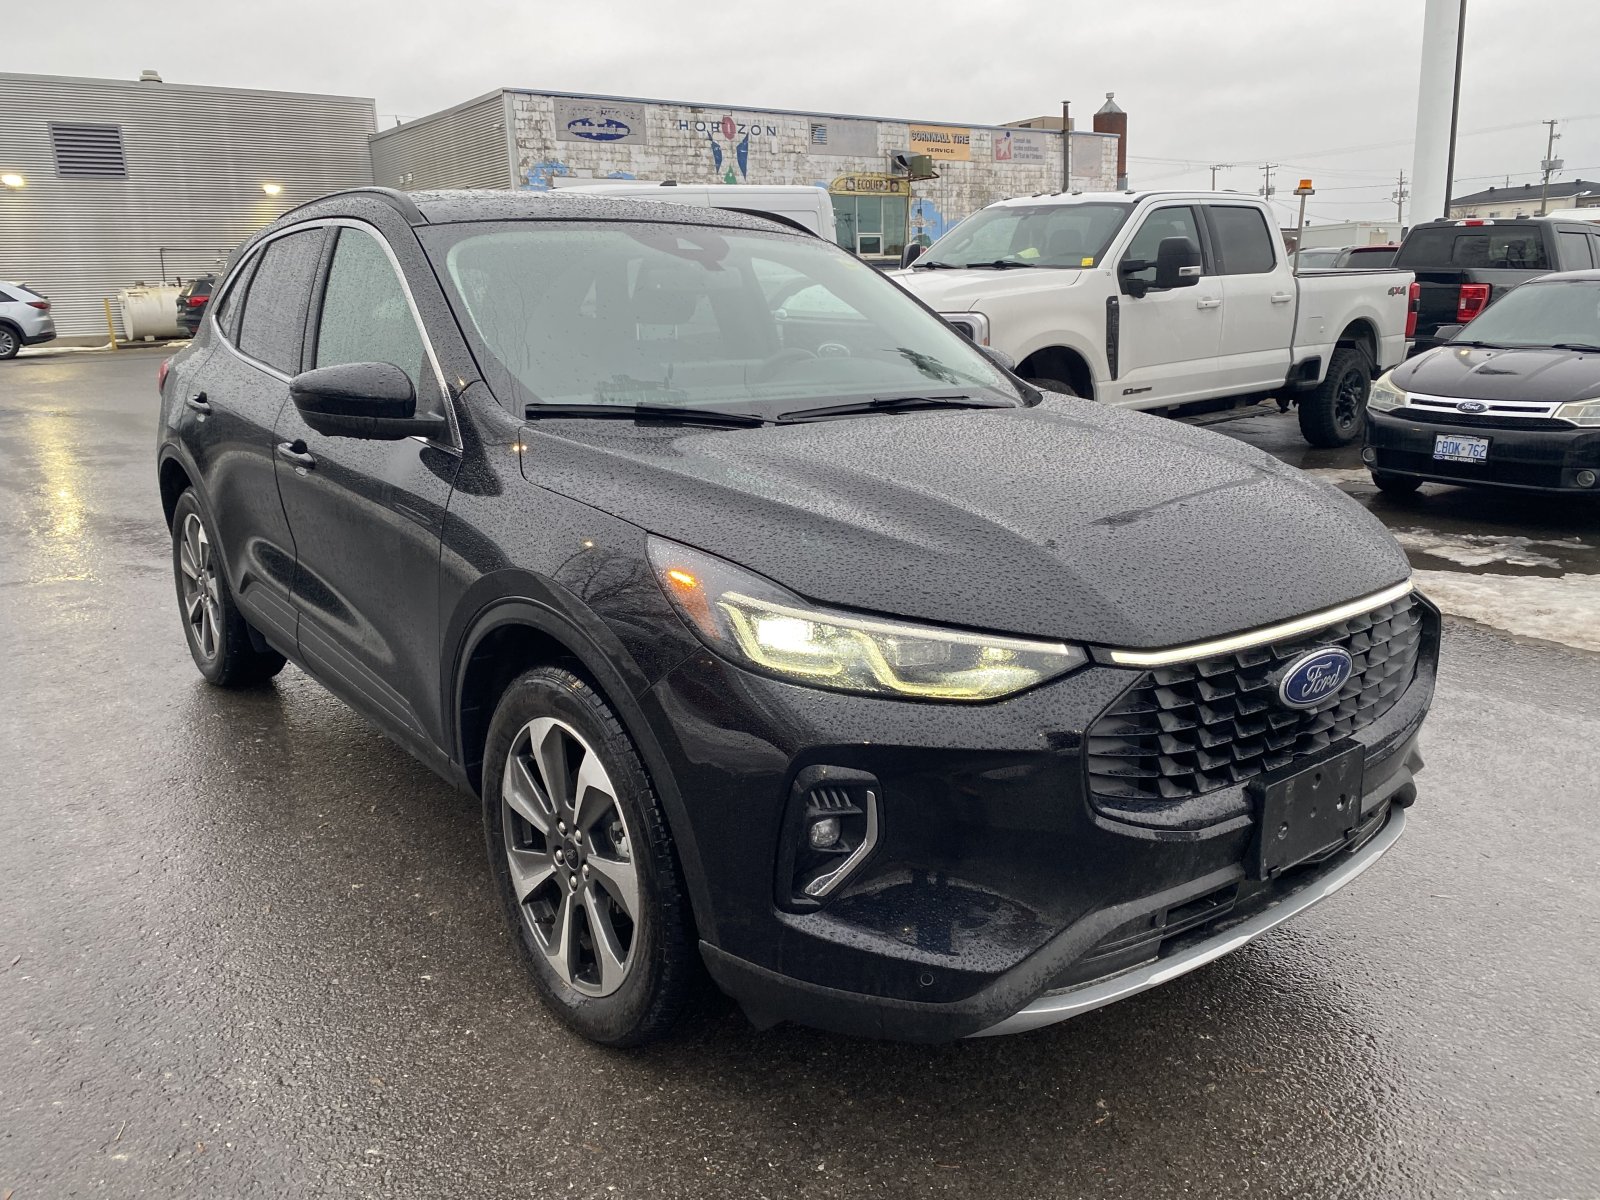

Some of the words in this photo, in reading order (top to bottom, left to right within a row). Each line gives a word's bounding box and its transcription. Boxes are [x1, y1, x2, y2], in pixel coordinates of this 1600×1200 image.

[911, 131, 951, 144] CORNWALL
[952, 133, 970, 145] TIRE
[1461, 402, 1481, 411] Ford
[1467, 443, 1487, 458] 762
[1301, 661, 1341, 698] Ford
